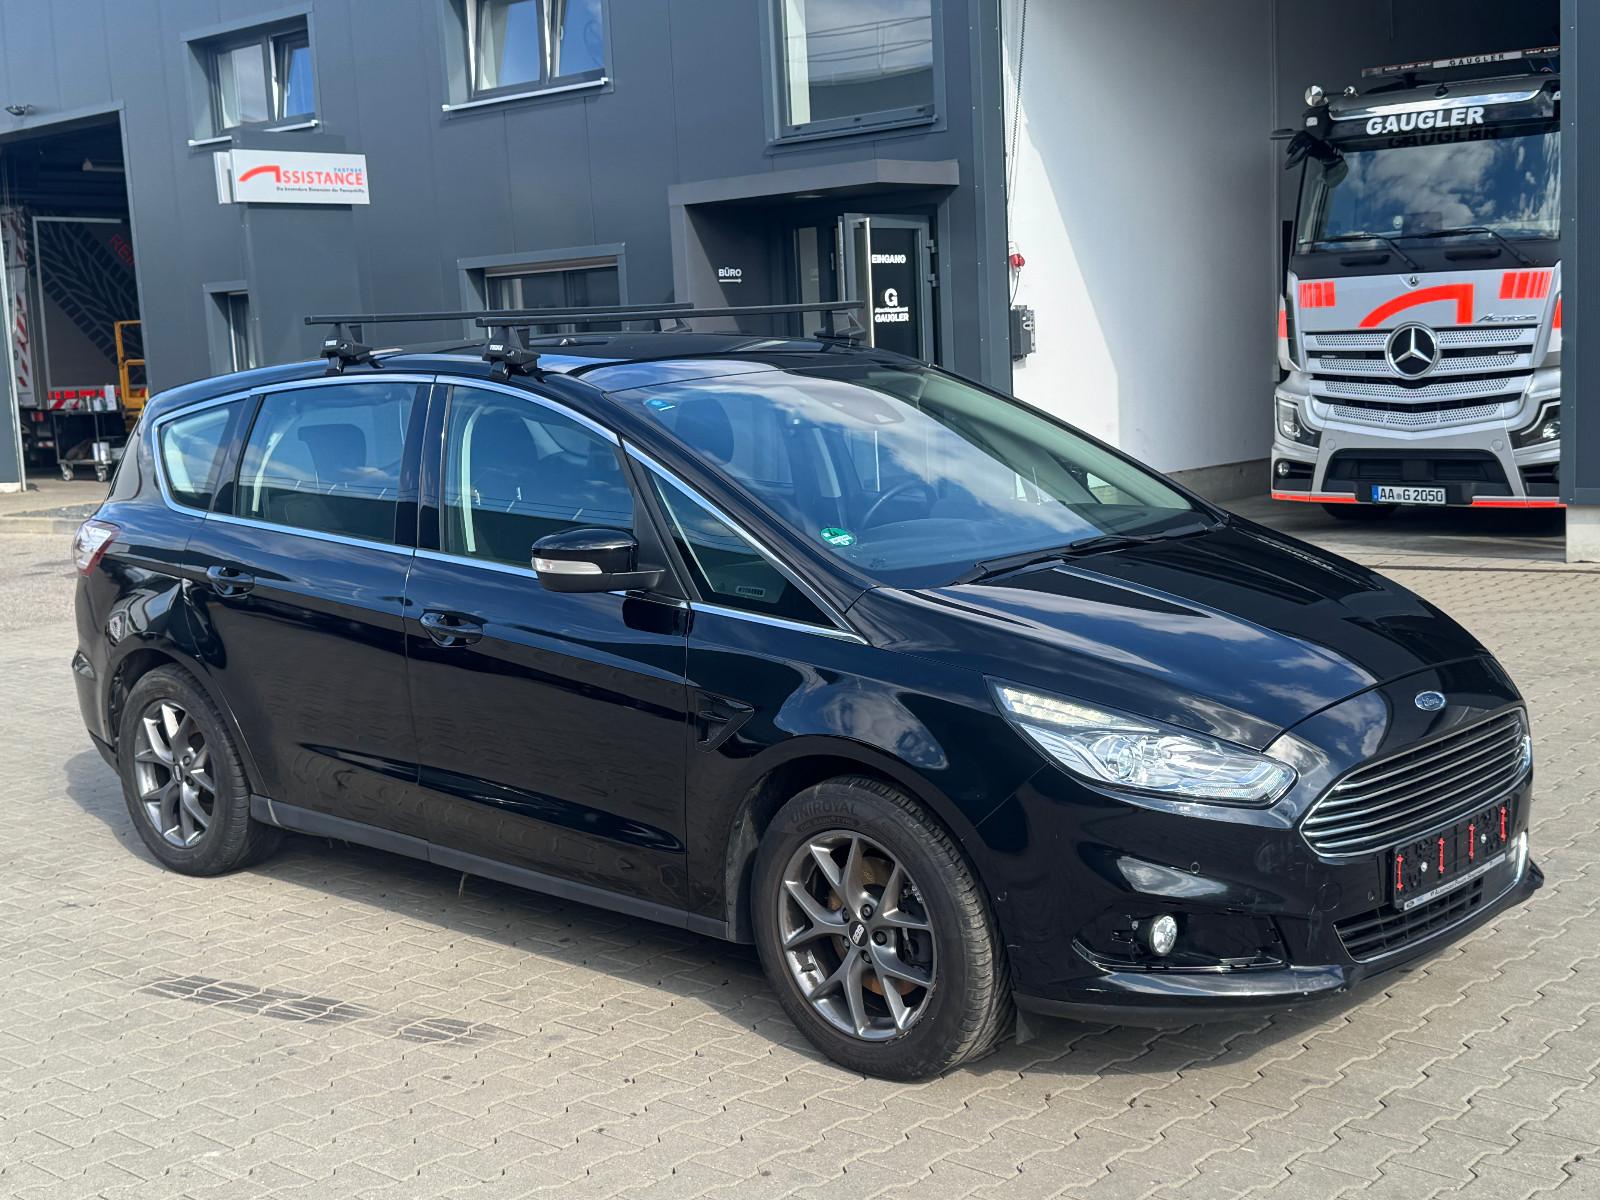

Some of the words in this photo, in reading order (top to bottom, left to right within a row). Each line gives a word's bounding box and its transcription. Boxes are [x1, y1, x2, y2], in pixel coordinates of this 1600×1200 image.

[1449, 53, 1504, 67] GAUGLER
[1366, 106, 1484, 135] GAUGLER
[871, 254, 907, 264] EINGANG
[718, 266, 742, 277] BÜRO
[884, 288, 898, 307] G
[874, 313, 909, 323] GAUGLER
[1380, 488, 1395, 501] AA
[1402, 489, 1411, 501] G
[1413, 490, 1443, 502] 2050
